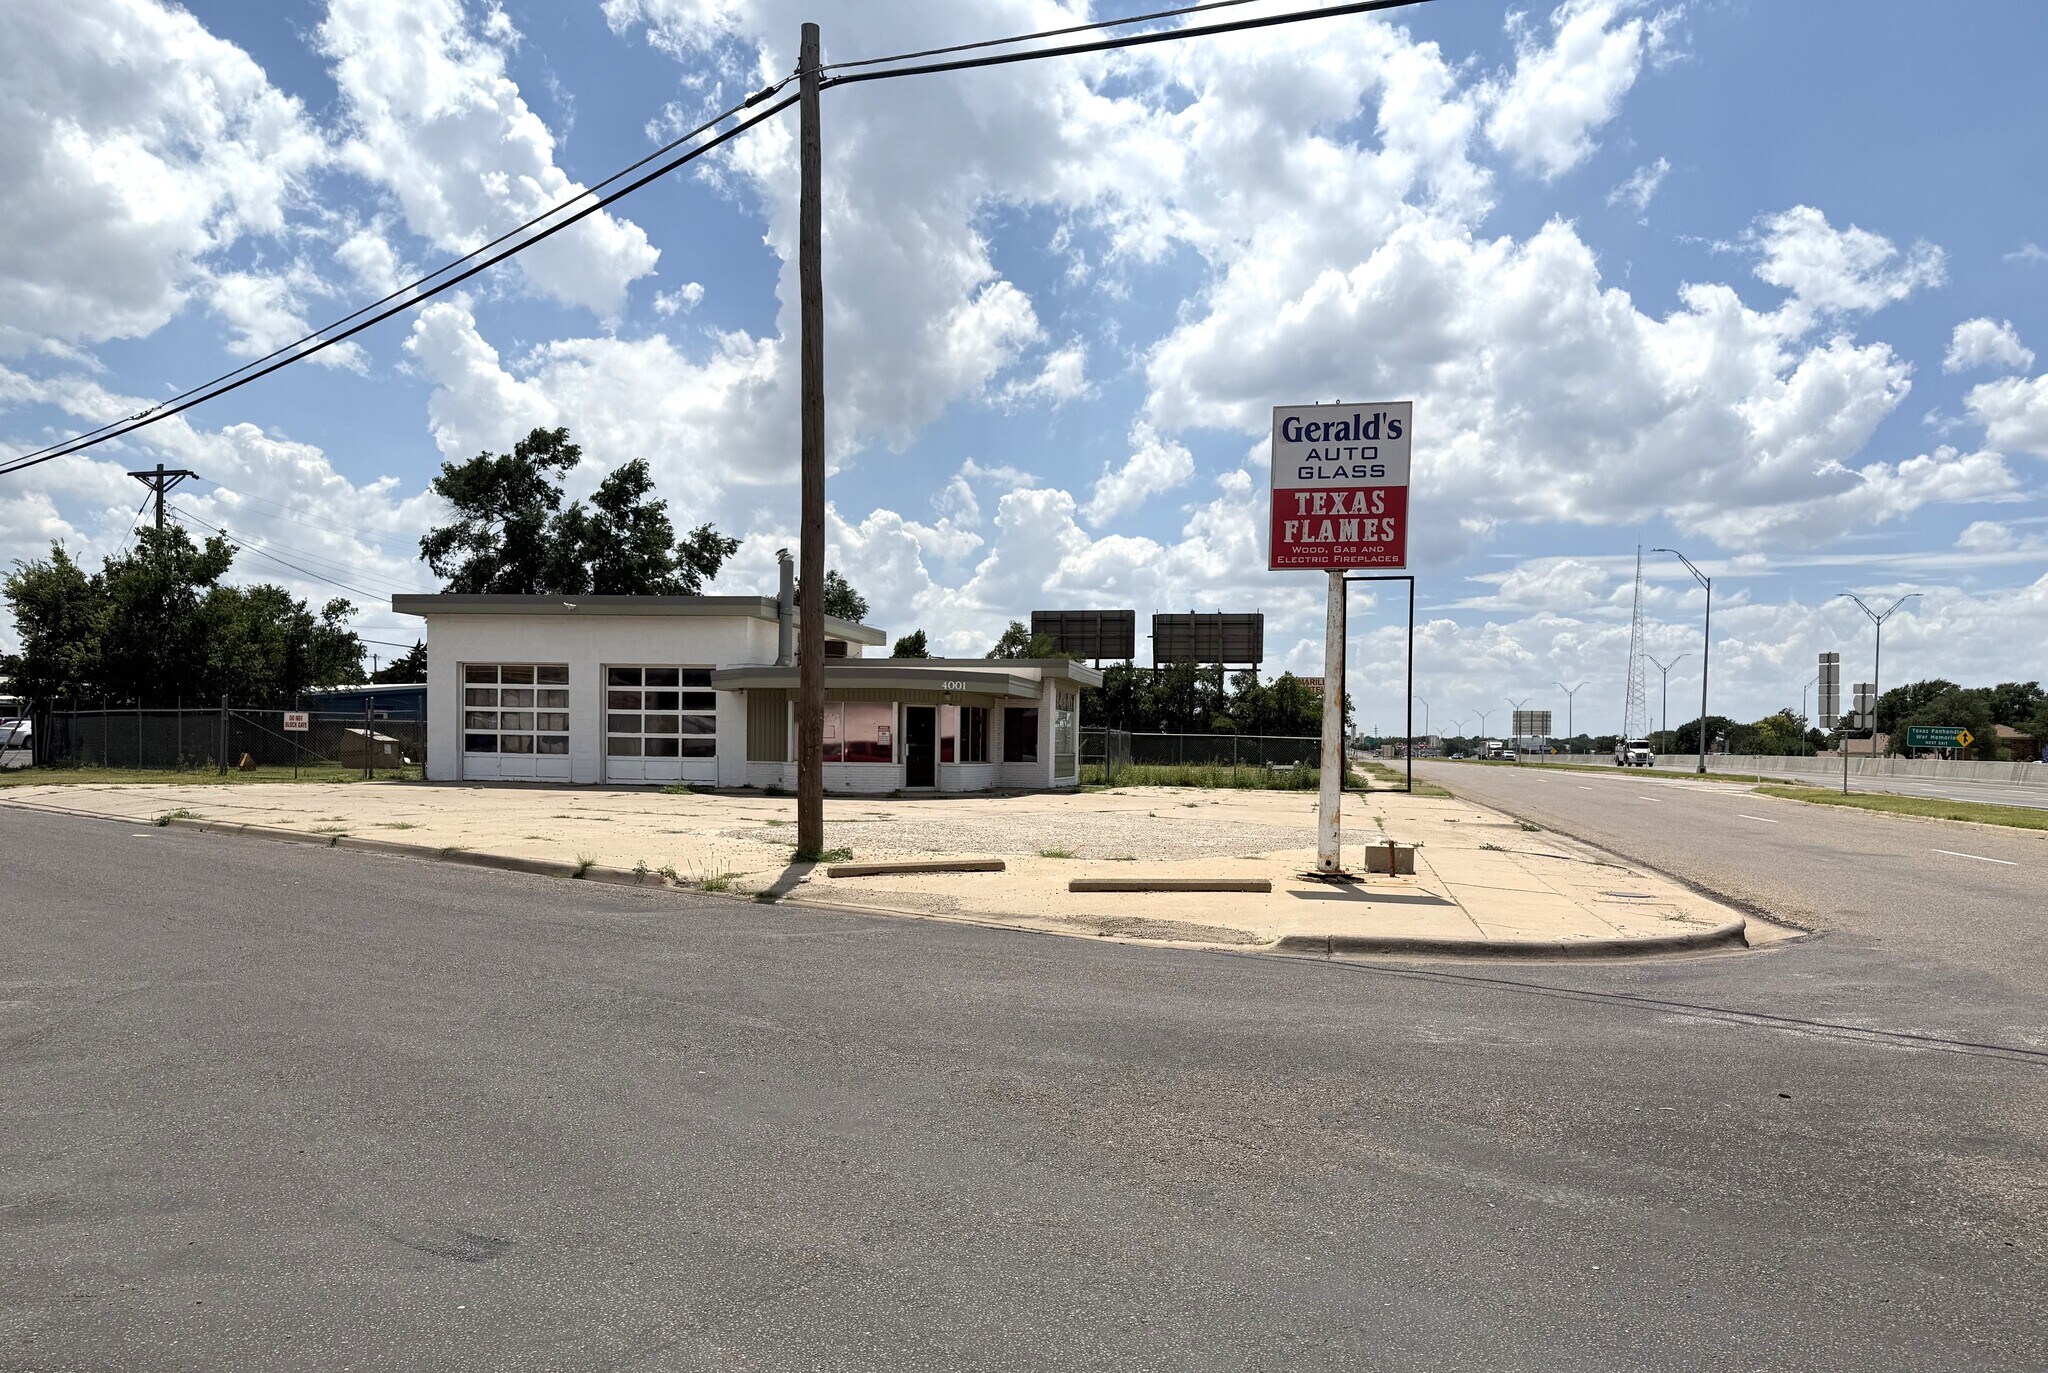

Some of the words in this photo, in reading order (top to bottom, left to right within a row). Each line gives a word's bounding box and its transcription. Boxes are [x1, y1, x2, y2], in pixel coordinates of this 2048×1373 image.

[1282, 412, 1403, 443] Gerald's
[1305, 446, 1378, 462] AUTO
[1298, 464, 1386, 480] GLASS
[1295, 489, 1385, 516] TEXAS
[1283, 517, 1395, 543] FLAMES
[1277, 555, 1329, 564] ELECTRIC
[1333, 555, 1399, 563] FIREPLACES
[941, 681, 966, 690] 4001
